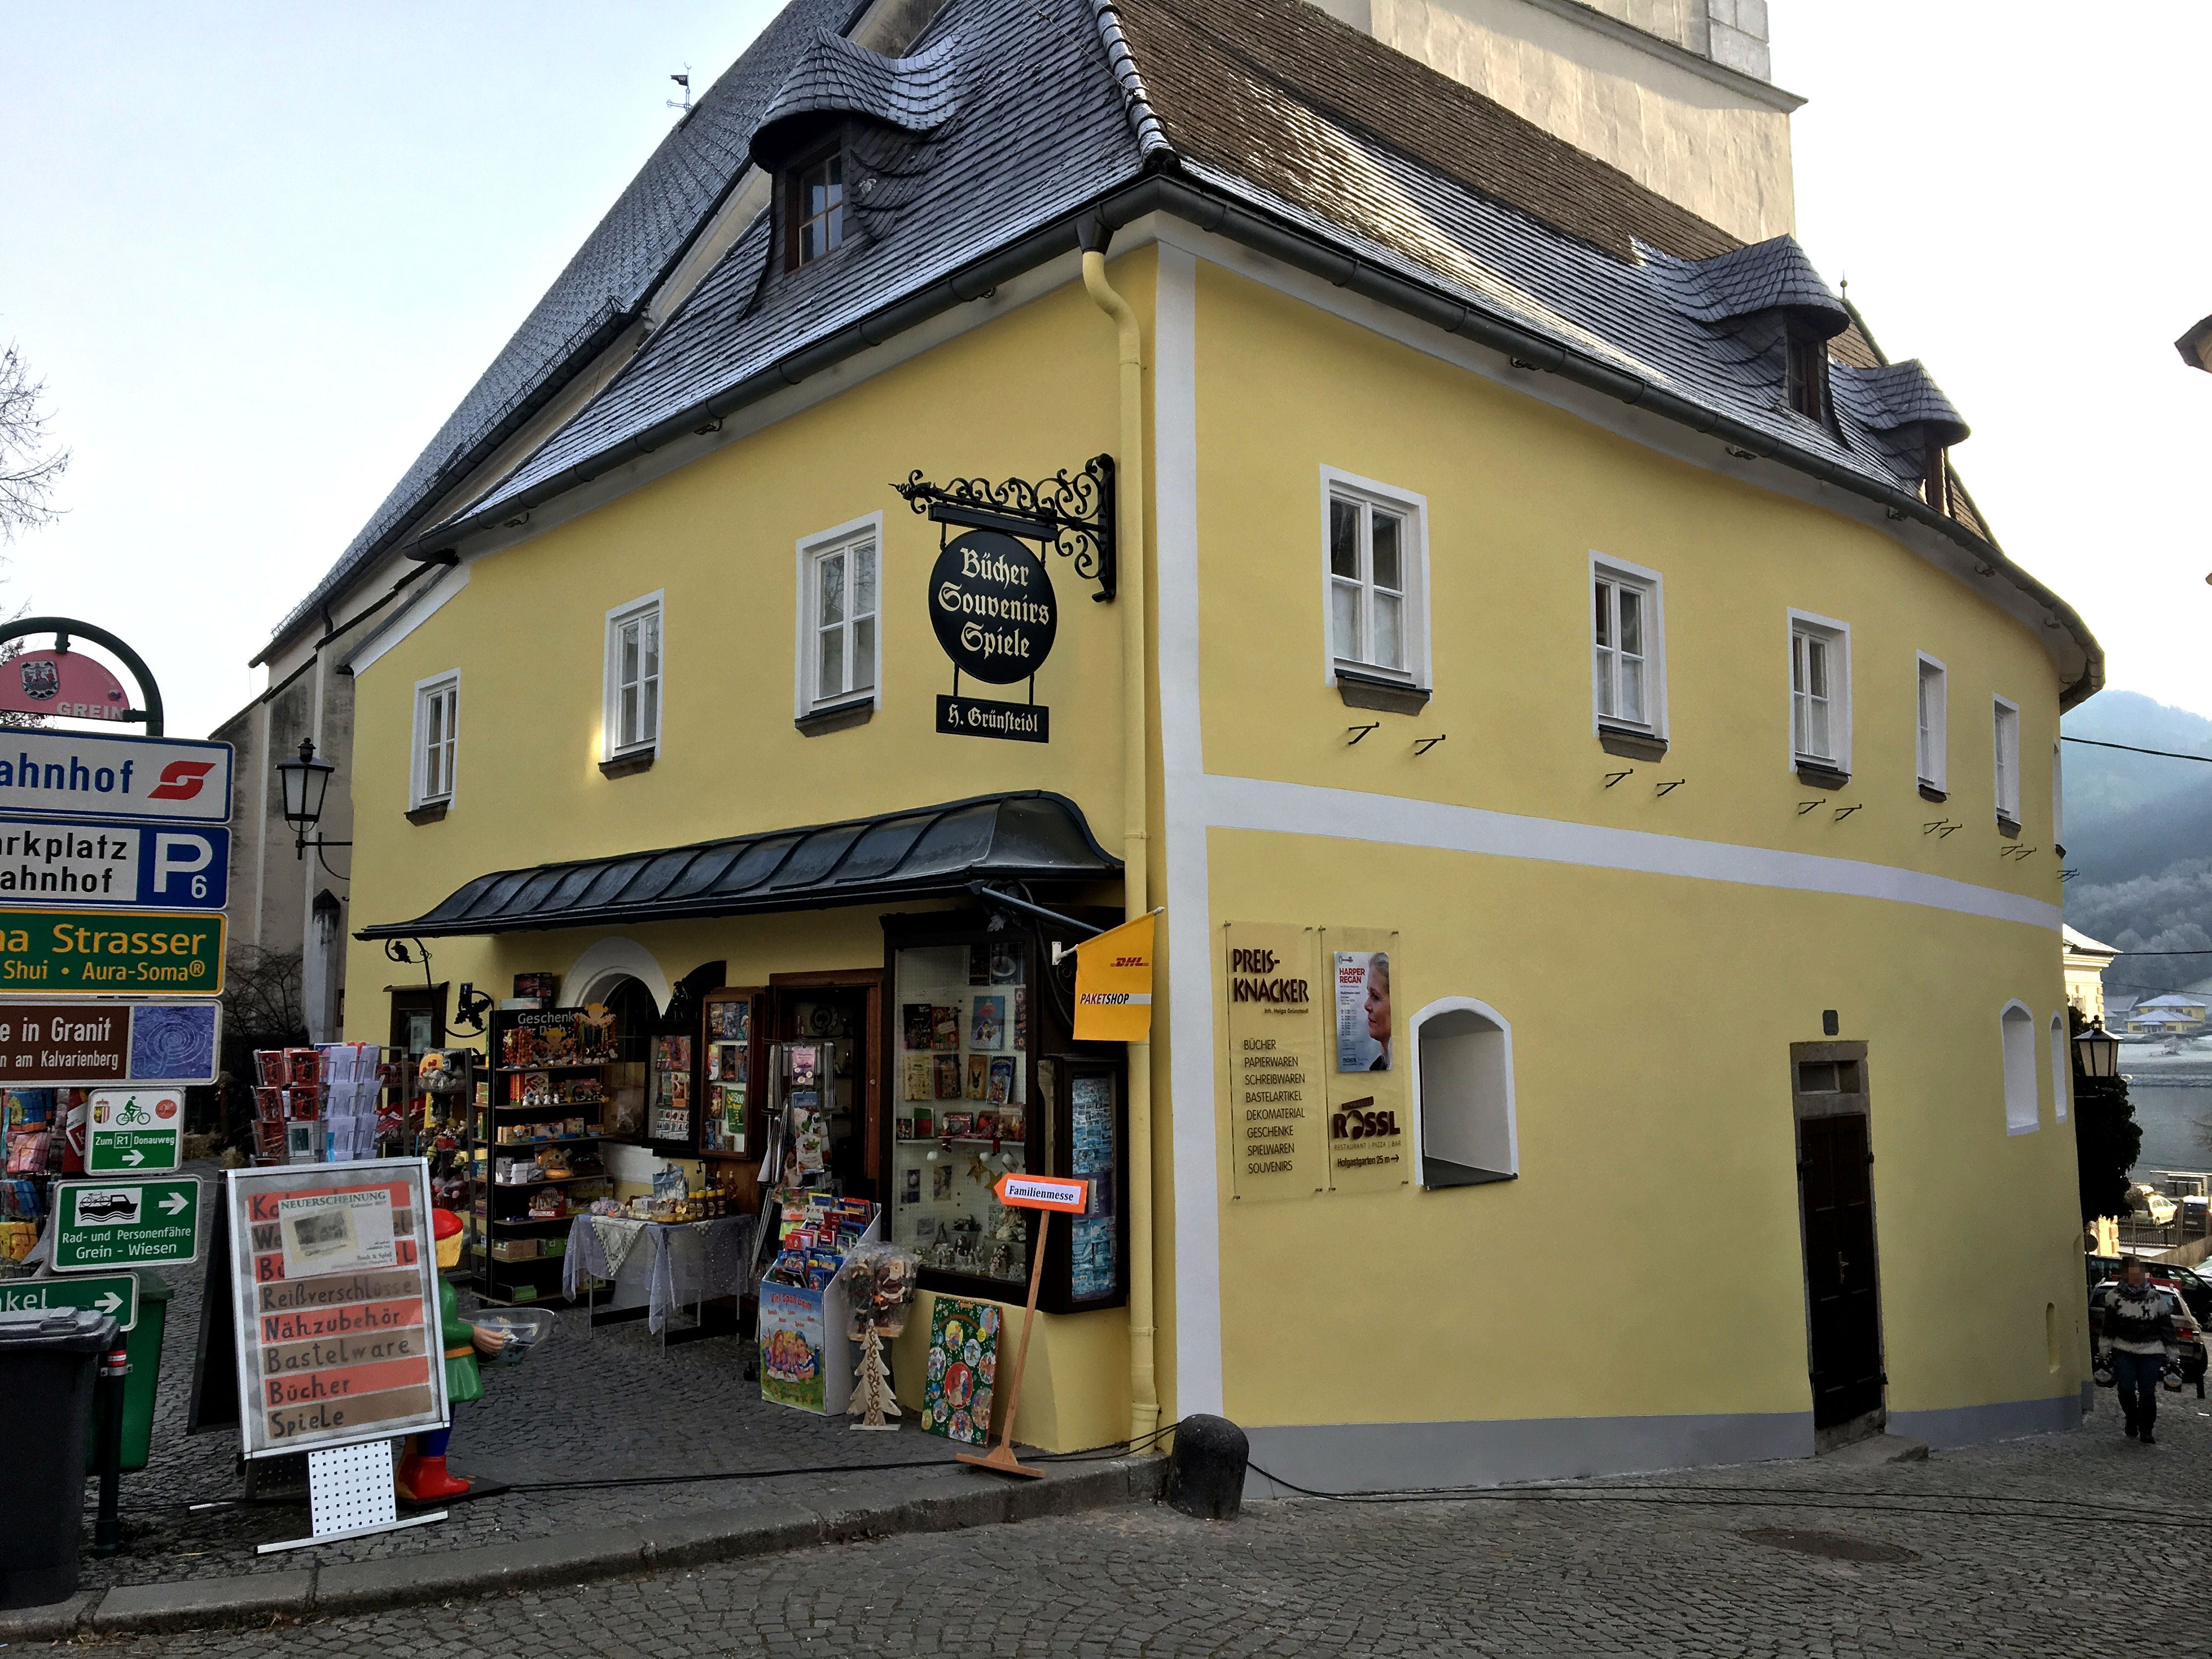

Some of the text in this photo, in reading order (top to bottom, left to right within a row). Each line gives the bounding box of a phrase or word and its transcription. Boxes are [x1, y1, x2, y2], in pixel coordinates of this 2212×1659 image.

[960, 548, 1029, 589] Bücher
[938, 581, 1049, 625] Souvenirs
[961, 622, 1030, 659] Spiele
[57, 702, 125, 720] GREIN
[0, 830, 213, 893] rkplatz P
[191, 875, 207, 899] 6
[52, 923, 207, 955] Strasser
[1115, 957, 1143, 967] DHL
[1233, 949, 1280, 973] PREIS-
[3, 960, 48, 980] Shui
[1233, 978, 1310, 1003] KNACKER
[1080, 994, 1130, 1005] PAKETSHOP
[517, 1011, 576, 1024] Geschenk
[22, 1017, 40, 1041] in
[51, 1017, 111, 1042] Granit
[1244, 1037, 1277, 1050] BÜCHER
[15, 1054, 33, 1068] am
[41, 1050, 119, 1070] Kalvarienberg
[1244, 1056, 1299, 1068] PAPIERWAREN
[1245, 1073, 1305, 1085] SCHREIBWAREN
[1246, 1090, 1302, 1103] BASTELARTIKEL
[1246, 1108, 1305, 1121] DEKOMATERIAL
[1247, 1125, 1294, 1138] GESCHENKE
[95, 1137, 112, 1146] Zum
[116, 1136, 129, 1145] R1
[134, 1136, 175, 1146] Donauweg
[1248, 1143, 1295, 1156] SPIELWAREN
[1334, 1143, 1366, 1151] RESTAURANT
[1248, 1160, 1293, 1174] SOUVENIRS
[1338, 1156, 1375, 1169] Hofgastgarten
[1376, 1155, 1383, 1164] 25
[280, 1191, 386, 1210] NEUERSCHEINUNG
[1009, 1185, 1074, 1201] Familienmesse
[62, 1227, 191, 1244] Rad- und Personenfähre
[76, 1245, 112, 1259] Grein
[128, 1243, 177, 1256] Wiesen
[0, 1288, 48, 1312] kel
[770, 1292, 781, 1303] Viel
[264, 1307, 399, 1342] Nähzubehör
[267, 1338, 410, 1373] Bastelware
[269, 1375, 349, 1405] Bücher
[270, 1406, 344, 1438] Spiele
